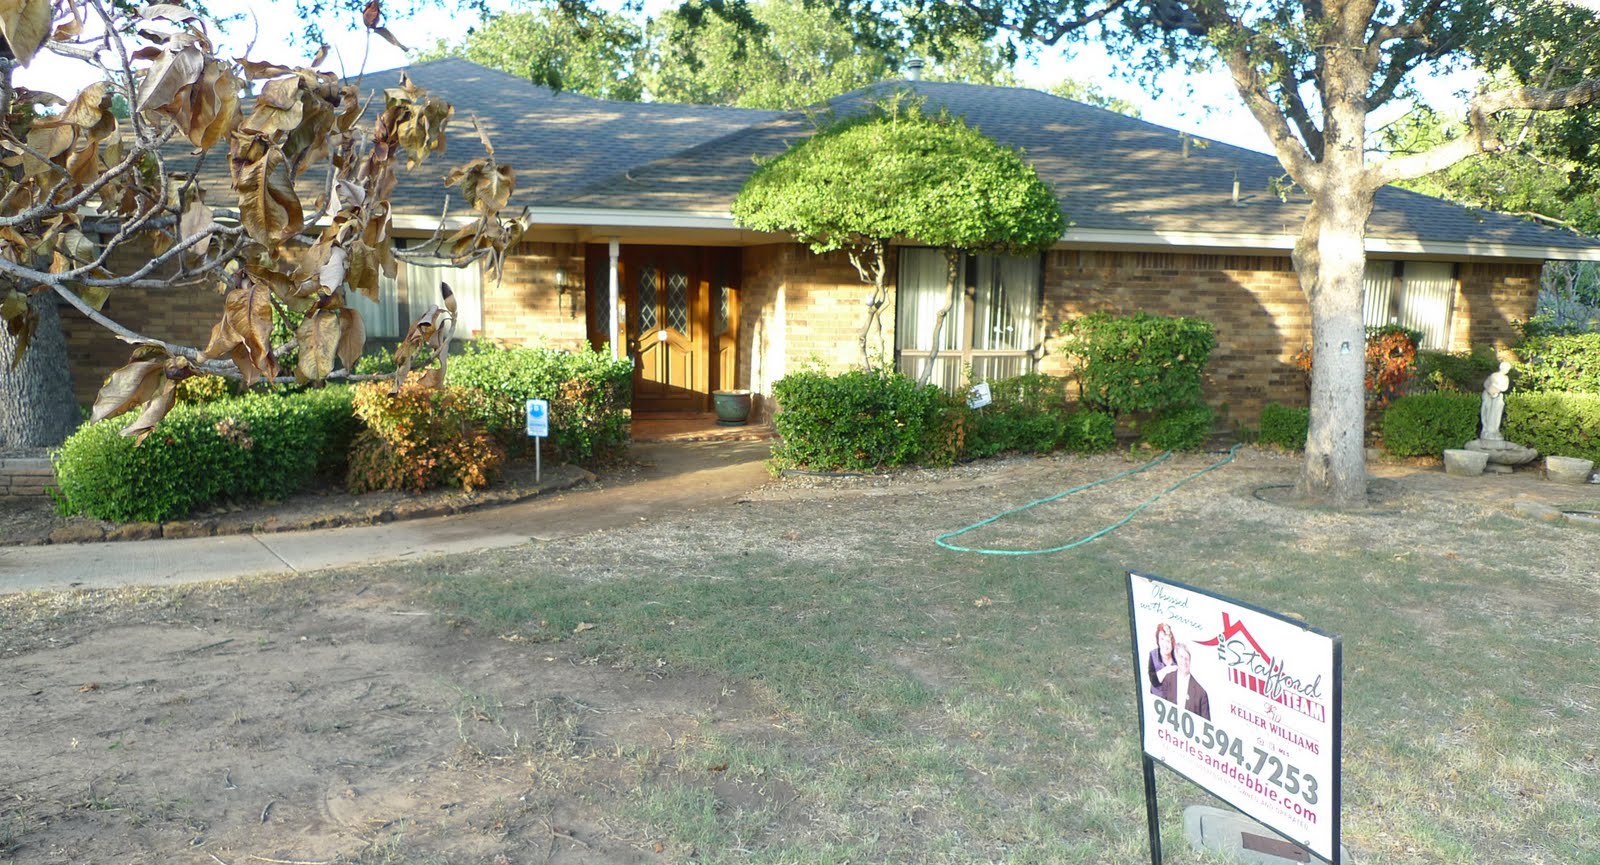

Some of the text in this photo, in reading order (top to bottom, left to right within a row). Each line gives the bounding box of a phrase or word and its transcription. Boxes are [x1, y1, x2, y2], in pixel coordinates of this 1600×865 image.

[1140, 602, 1203, 631] with Service
[1217, 633, 1227, 661] The
[1227, 639, 1321, 698] Stafford
[1230, 704, 1319, 755] KELLER WILLIAMS
[1284, 690, 1325, 723] TEAM
[1154, 699, 1319, 805] 940.594.7253
[1158, 728, 1317, 825] charlesanddebbie.com
